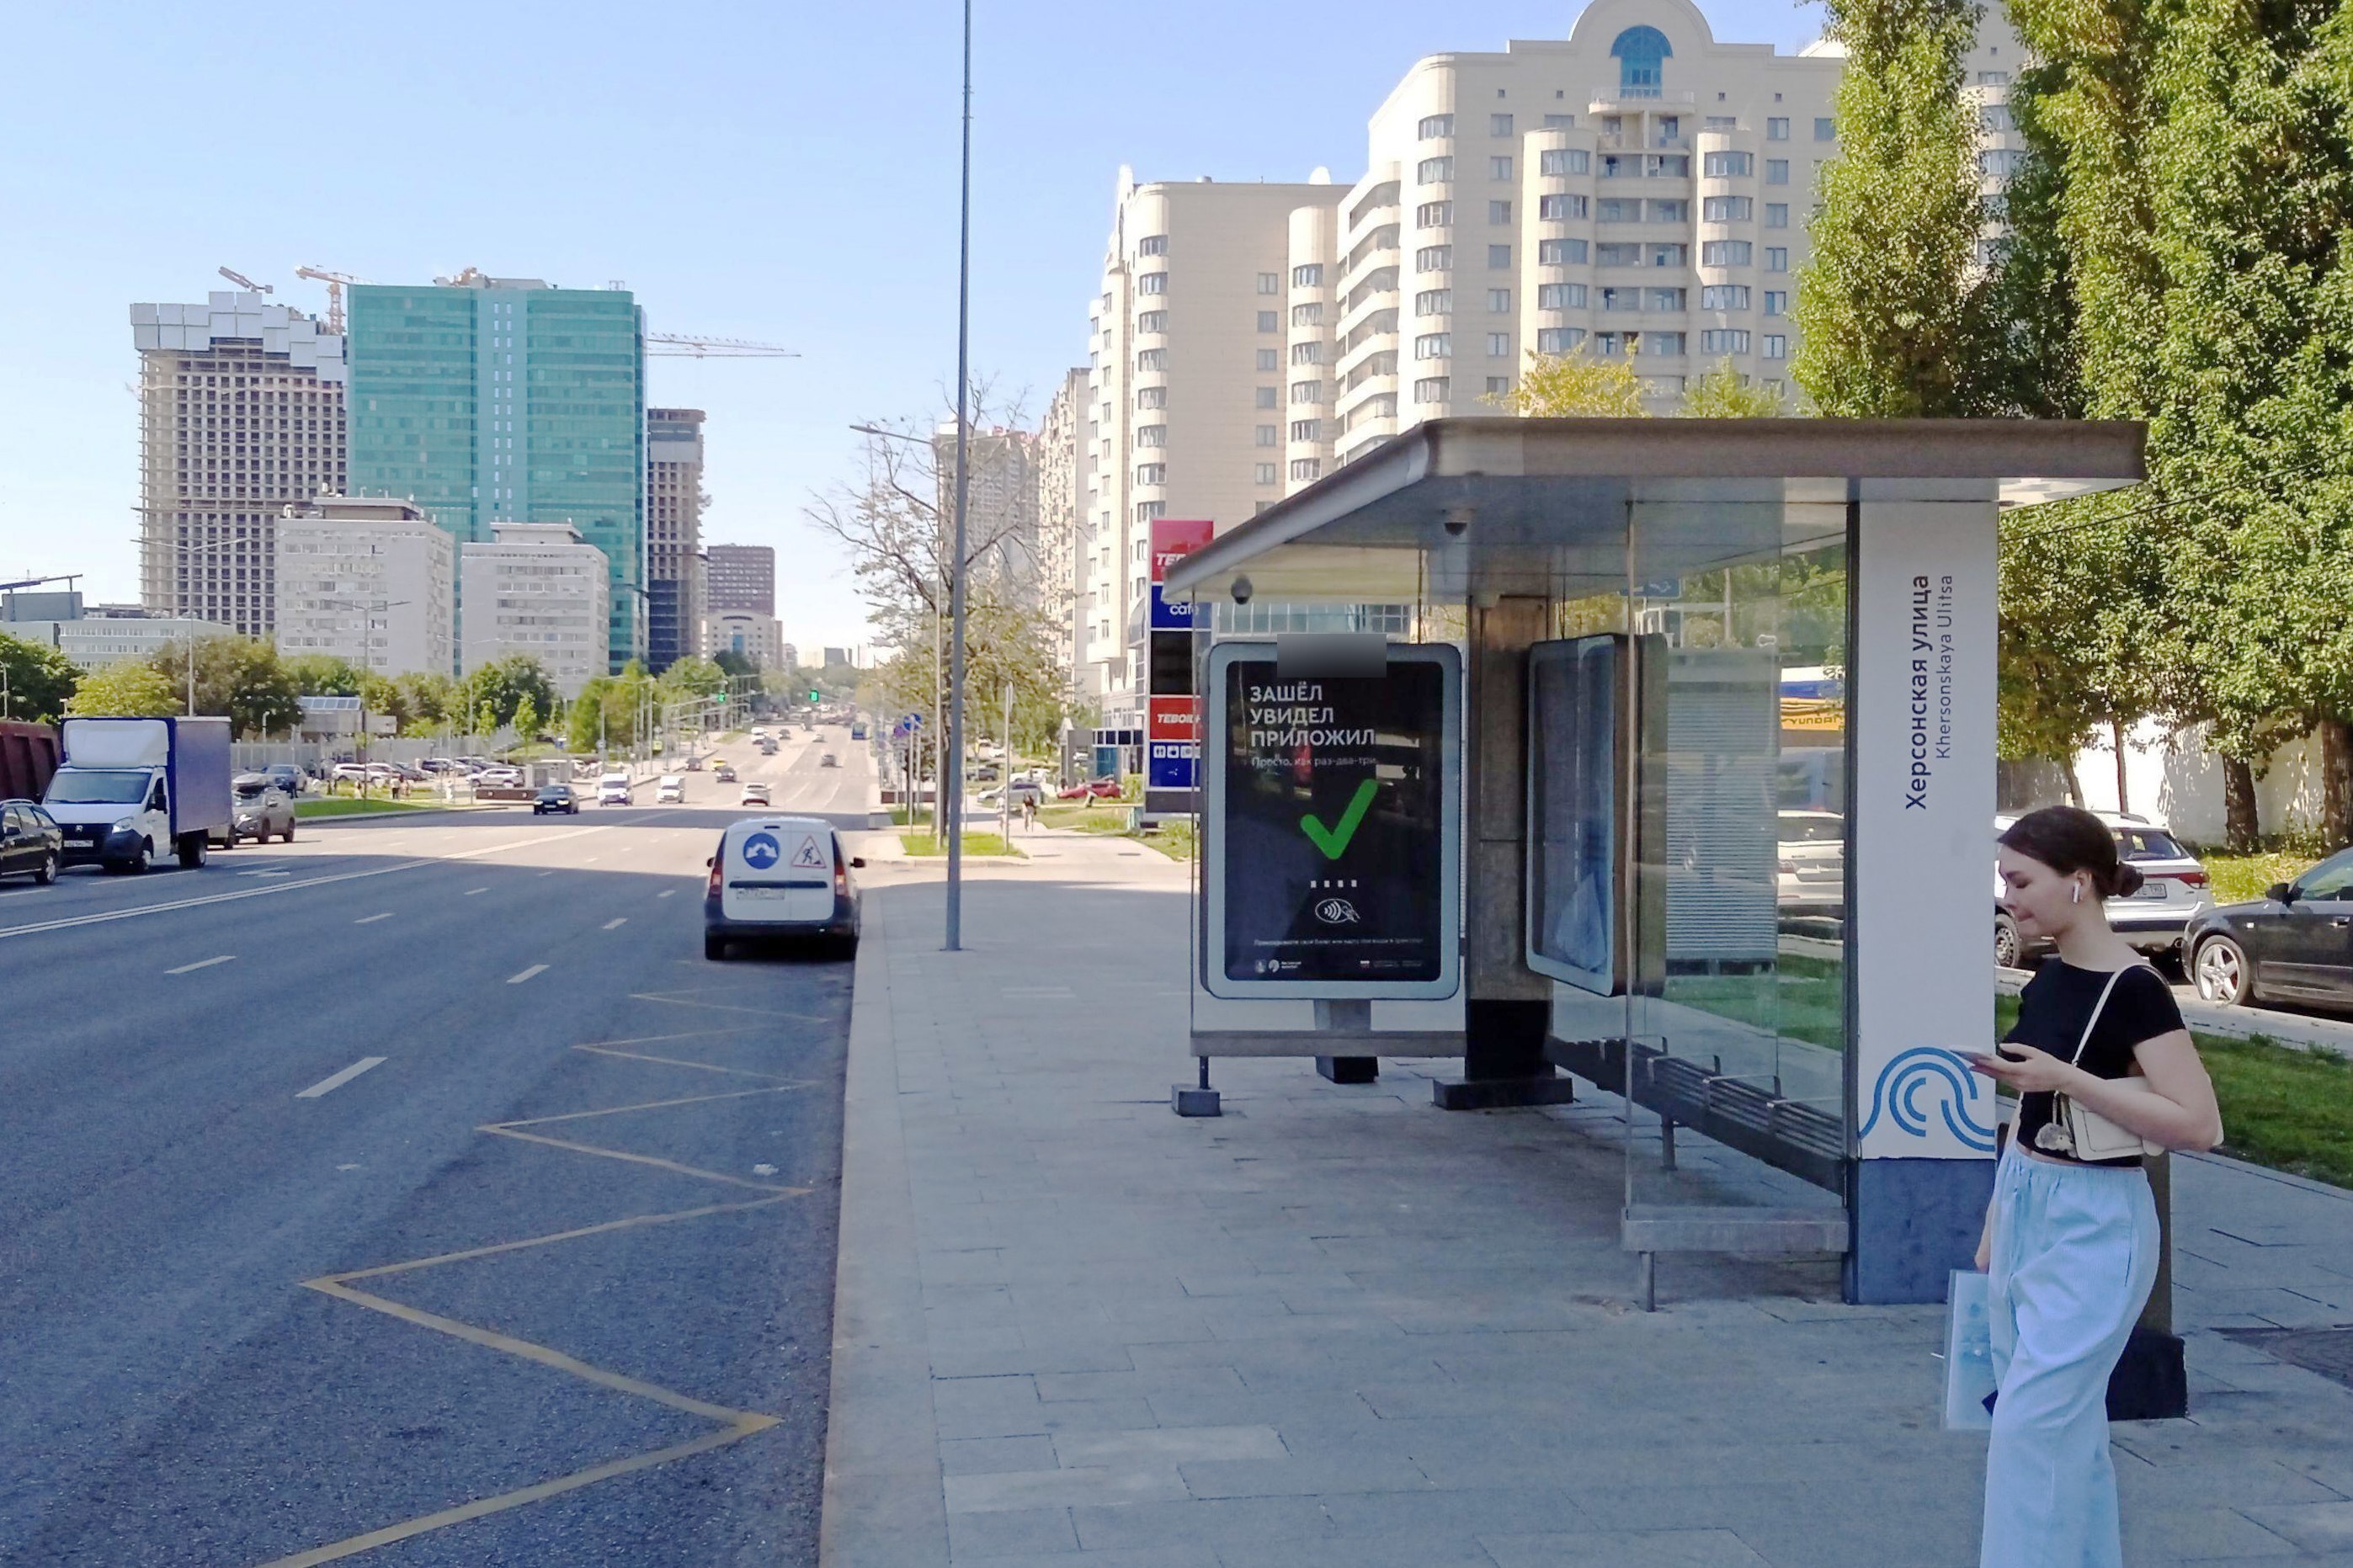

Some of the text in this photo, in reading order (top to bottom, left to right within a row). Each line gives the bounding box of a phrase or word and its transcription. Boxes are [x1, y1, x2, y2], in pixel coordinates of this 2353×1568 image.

[1936, 576, 1954, 759] Khersonskaya Ulitsa
[1250, 681, 1323, 702] ЗАШЁЛ
[1905, 576, 1933, 810] Херсонская улица
[1250, 708, 1334, 726] УВИДЕЛ
[1250, 729, 1376, 747] ПРИЛОЖИЛ
